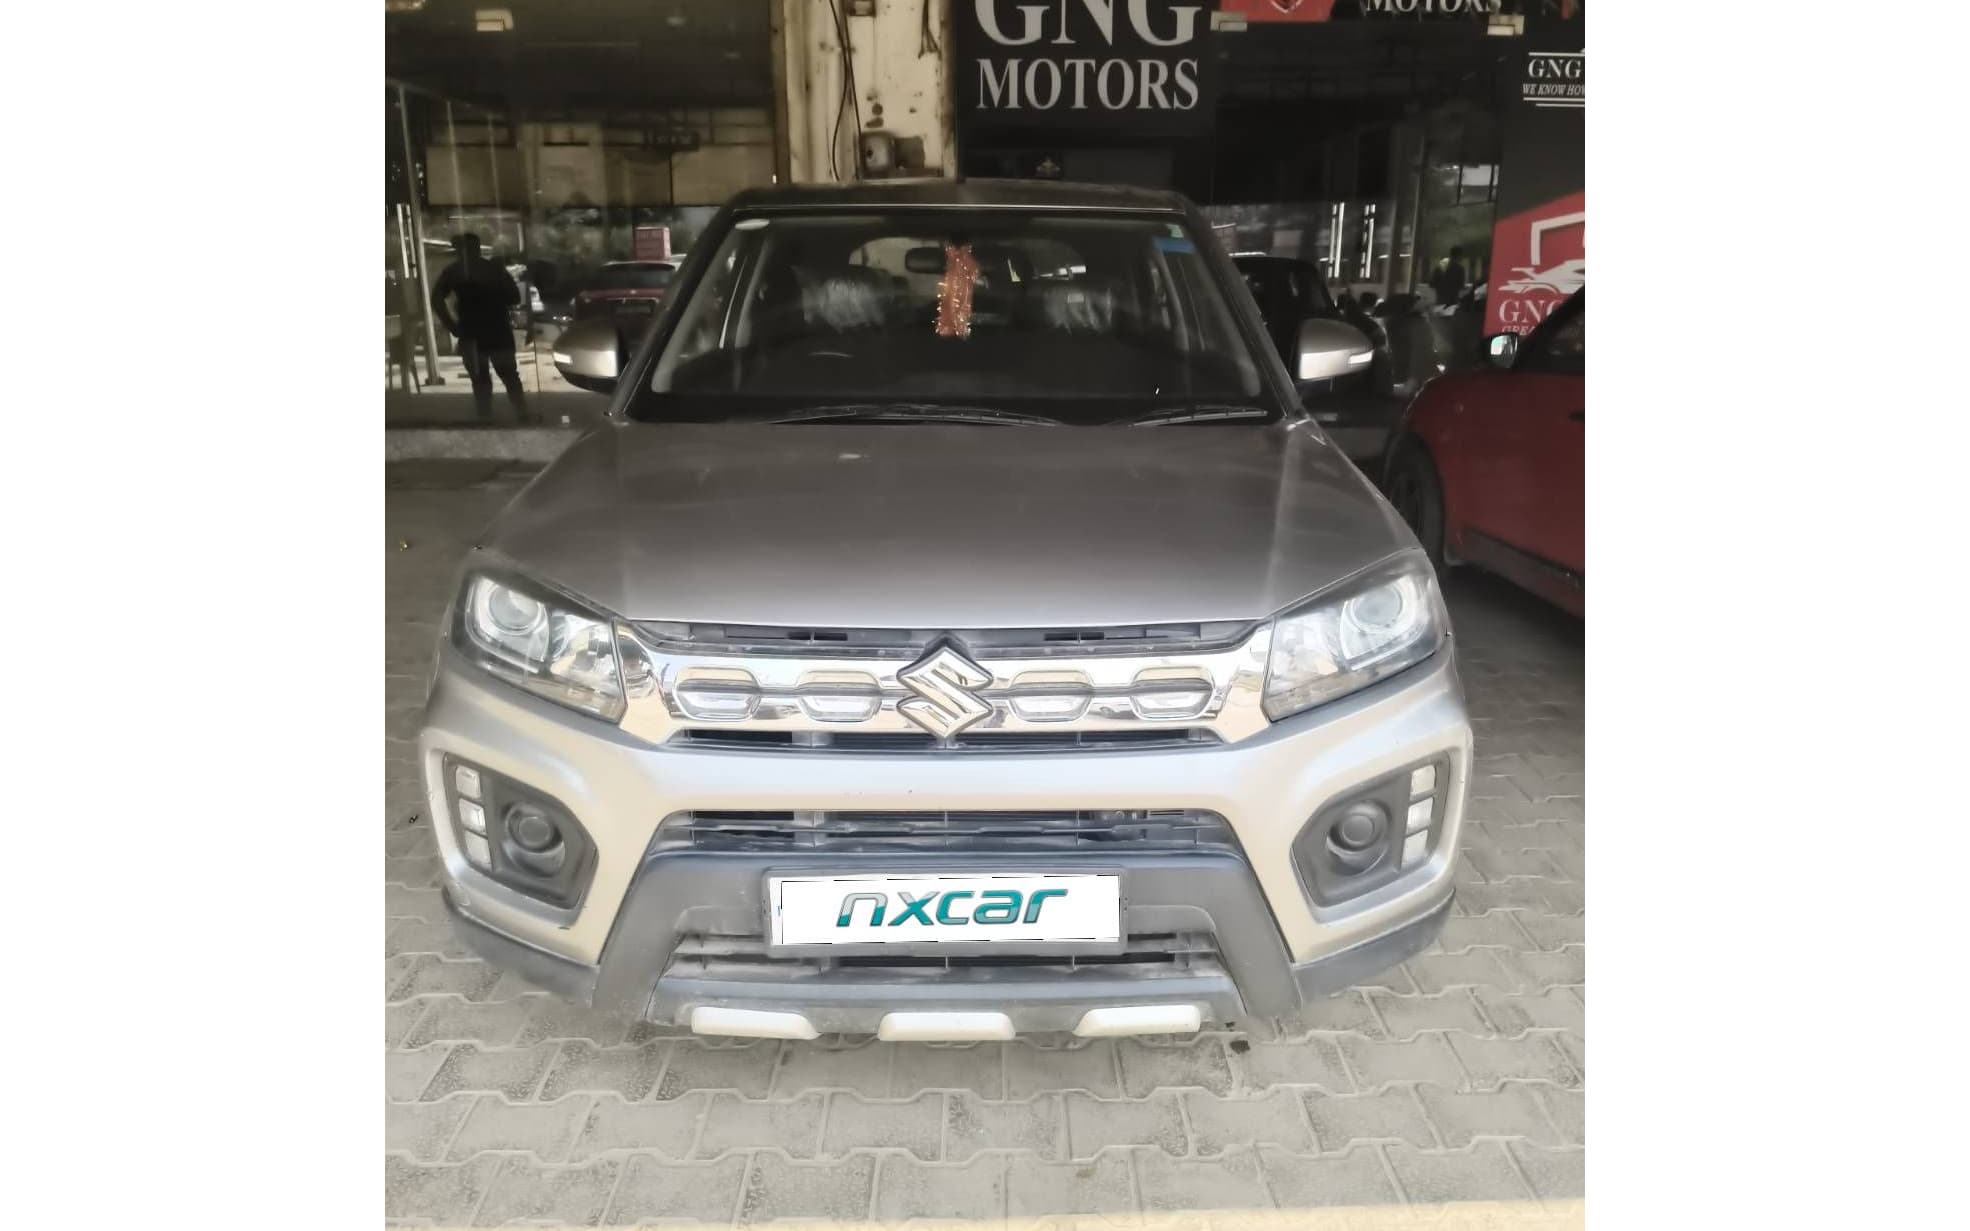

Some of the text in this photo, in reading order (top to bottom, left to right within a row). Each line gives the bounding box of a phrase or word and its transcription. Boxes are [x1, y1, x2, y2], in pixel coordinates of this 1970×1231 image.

[973, 0, 1202, 46] GNG
[975, 58, 1199, 110] MOTORS
[1528, 58, 1581, 78] GNG
